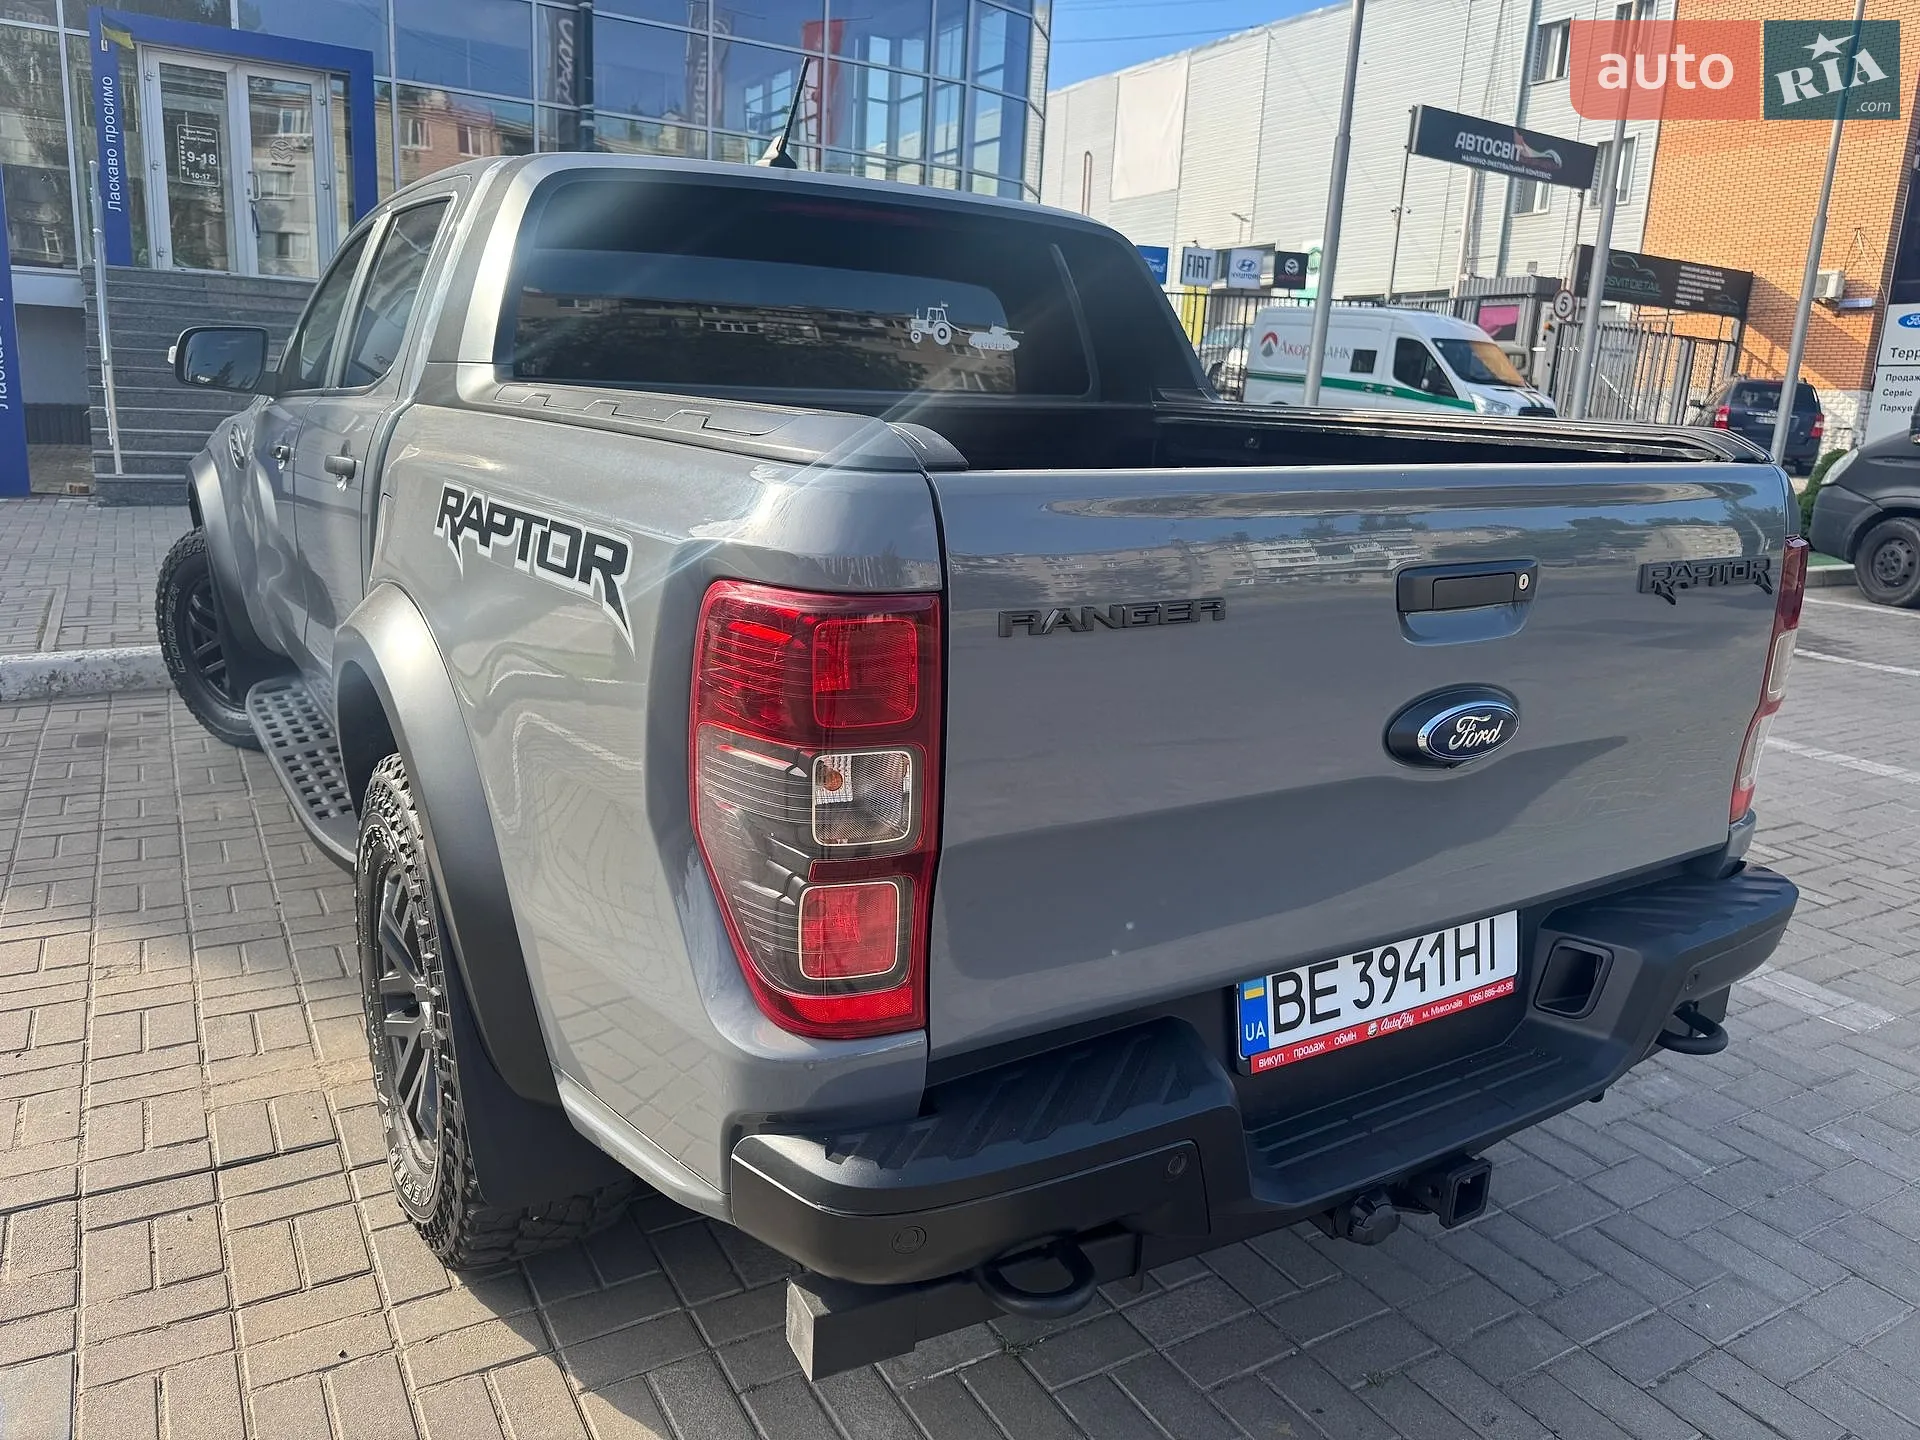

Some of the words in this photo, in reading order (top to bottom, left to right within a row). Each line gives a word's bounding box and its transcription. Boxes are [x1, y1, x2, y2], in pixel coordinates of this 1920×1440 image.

[102, 76, 119, 143] просимо
[187, 151, 217, 165] 9-18
[1455, 132, 1522, 161] АВТОСВІТ
[106, 148, 121, 212] Ласкаво
[1185, 253, 1212, 280] FIAT
[1882, 388, 1913, 398] Сервіс
[434, 483, 635, 656] RAPTOR
[1638, 555, 1773, 605] RAPTOR
[998, 597, 1226, 637] RANGER
[1449, 714, 1504, 750] Ford
[1271, 959, 1342, 1035] BE
[1245, 1020, 1267, 1042] UA
[1258, 1052, 1285, 1068] викуп
[1293, 1039, 1326, 1059] продаж
[1333, 1030, 1358, 1046] обмін
